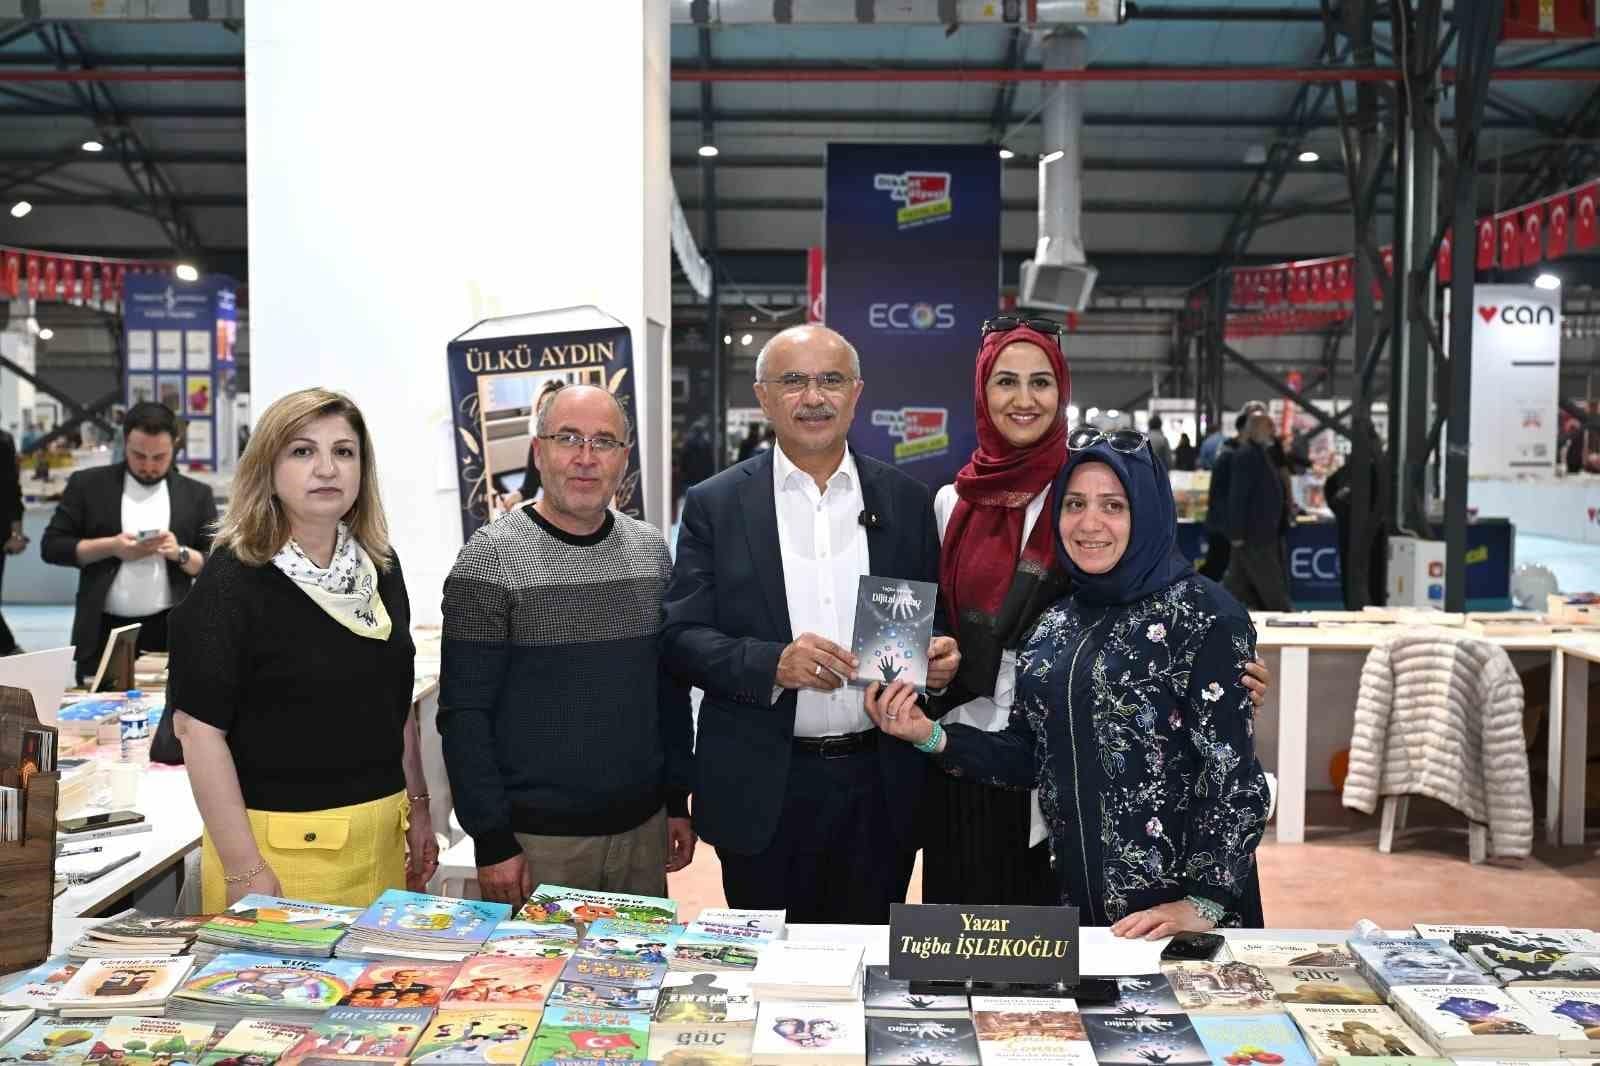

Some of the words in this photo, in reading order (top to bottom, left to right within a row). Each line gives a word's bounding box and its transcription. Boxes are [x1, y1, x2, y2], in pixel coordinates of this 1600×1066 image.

[869, 303, 955, 329] ECOS
[1501, 305, 1554, 325] can
[466, 344, 531, 372] ÜLKÜ
[539, 342, 615, 367] AYDIN
[960, 913, 1010, 932] Yazar
[899, 935, 951, 959] Tuğba
[955, 932, 1070, 960] İŞLEKOĞLU
